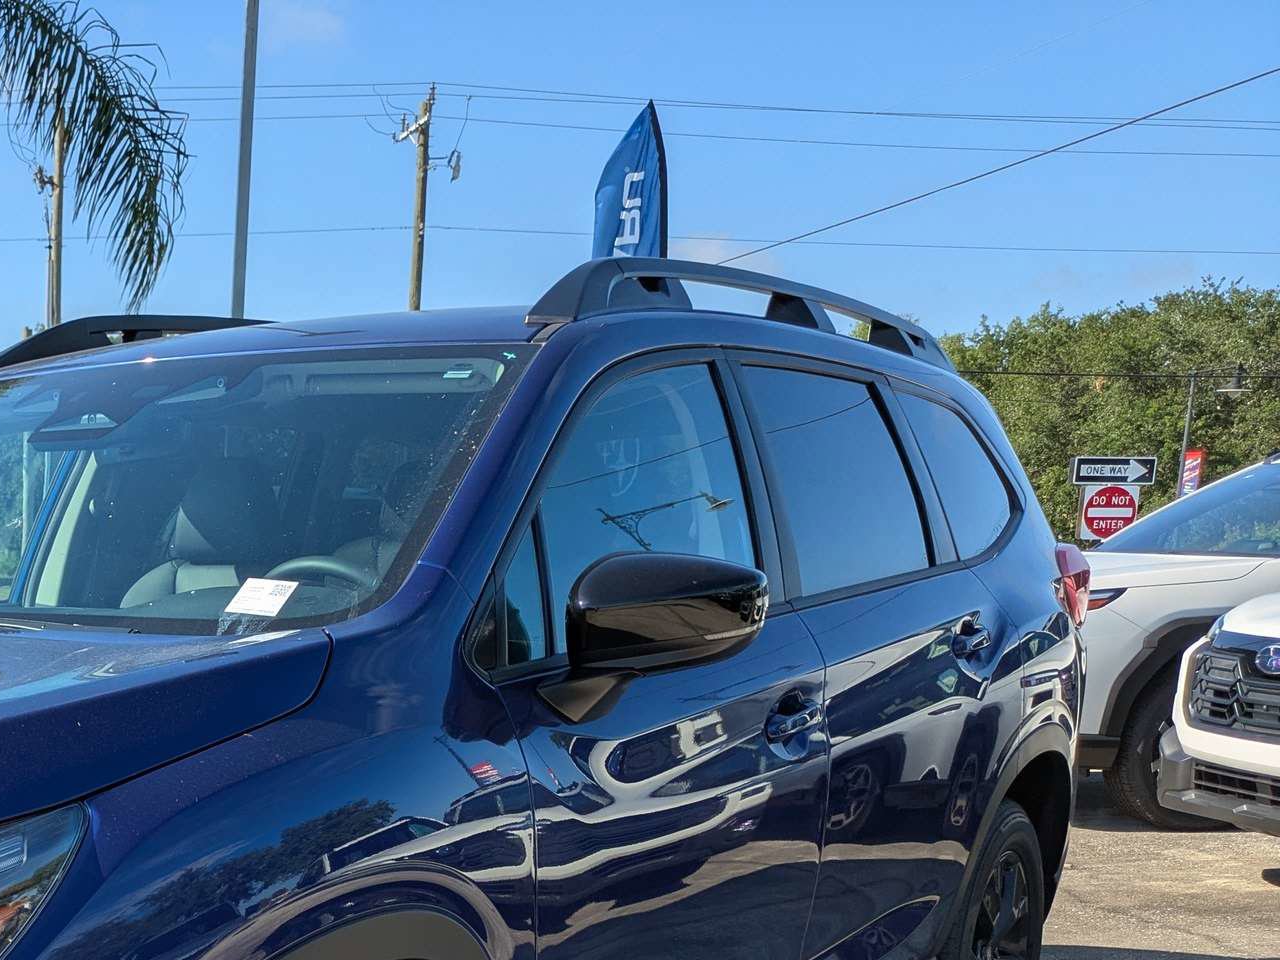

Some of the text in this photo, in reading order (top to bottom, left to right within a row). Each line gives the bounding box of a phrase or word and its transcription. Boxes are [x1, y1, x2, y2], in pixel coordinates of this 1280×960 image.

[1086, 466, 1129, 475] ONE WAY
[1092, 496, 1131, 505] DO NOT
[1093, 520, 1124, 529] ENTER
